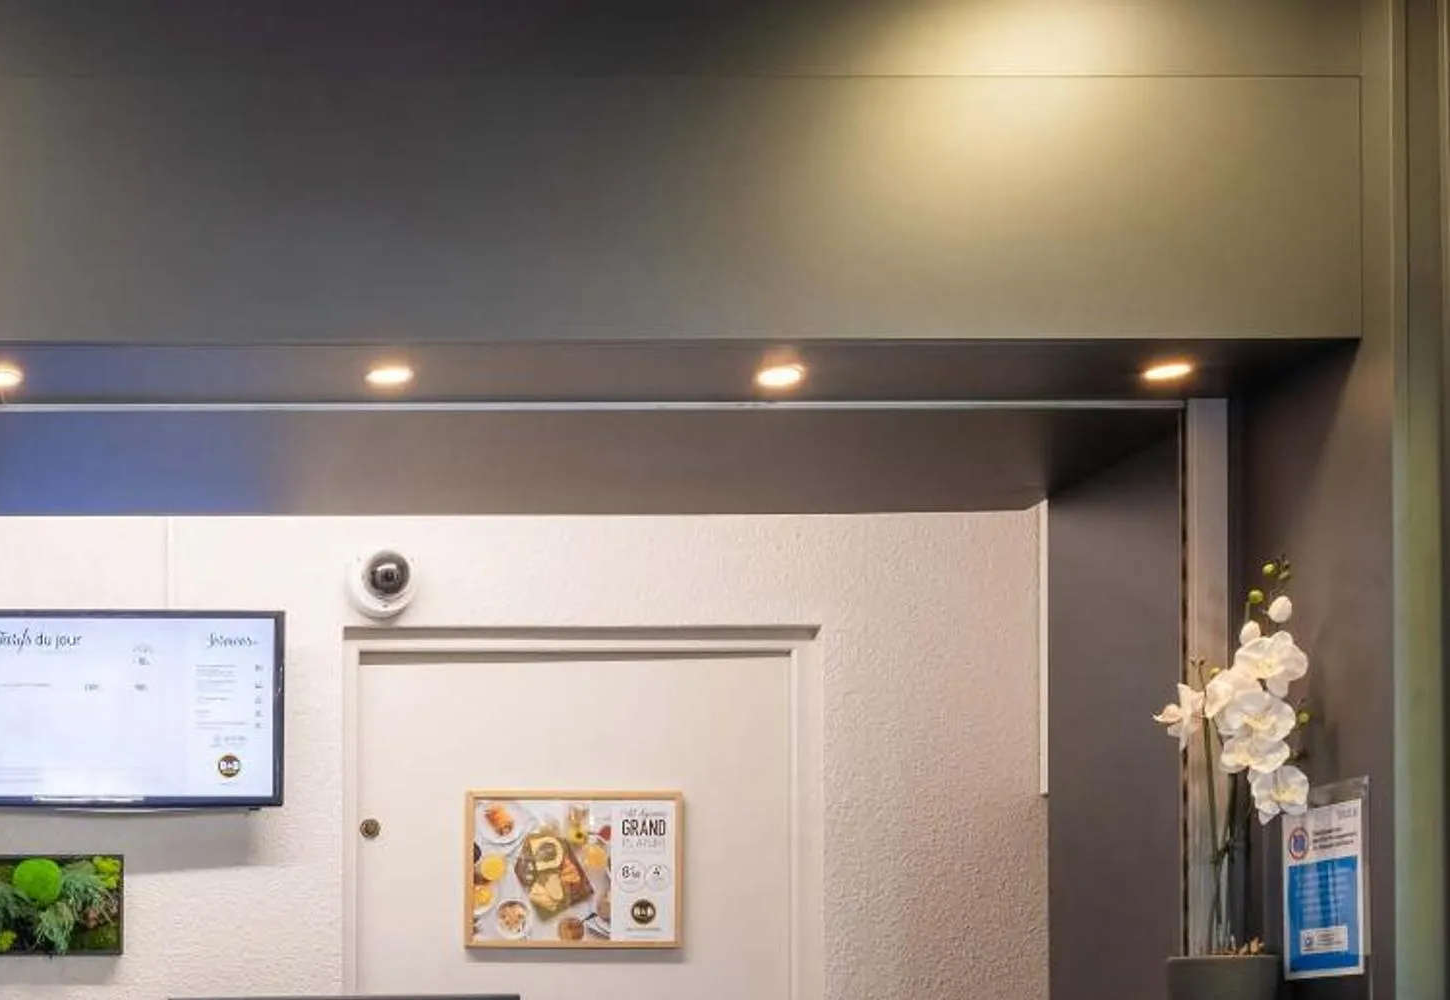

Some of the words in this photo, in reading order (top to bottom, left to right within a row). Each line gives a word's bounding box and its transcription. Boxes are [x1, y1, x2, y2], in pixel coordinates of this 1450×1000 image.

[35, 632, 51, 646] du
[55, 634, 82, 650] jour
[621, 819, 667, 837] GRAND
